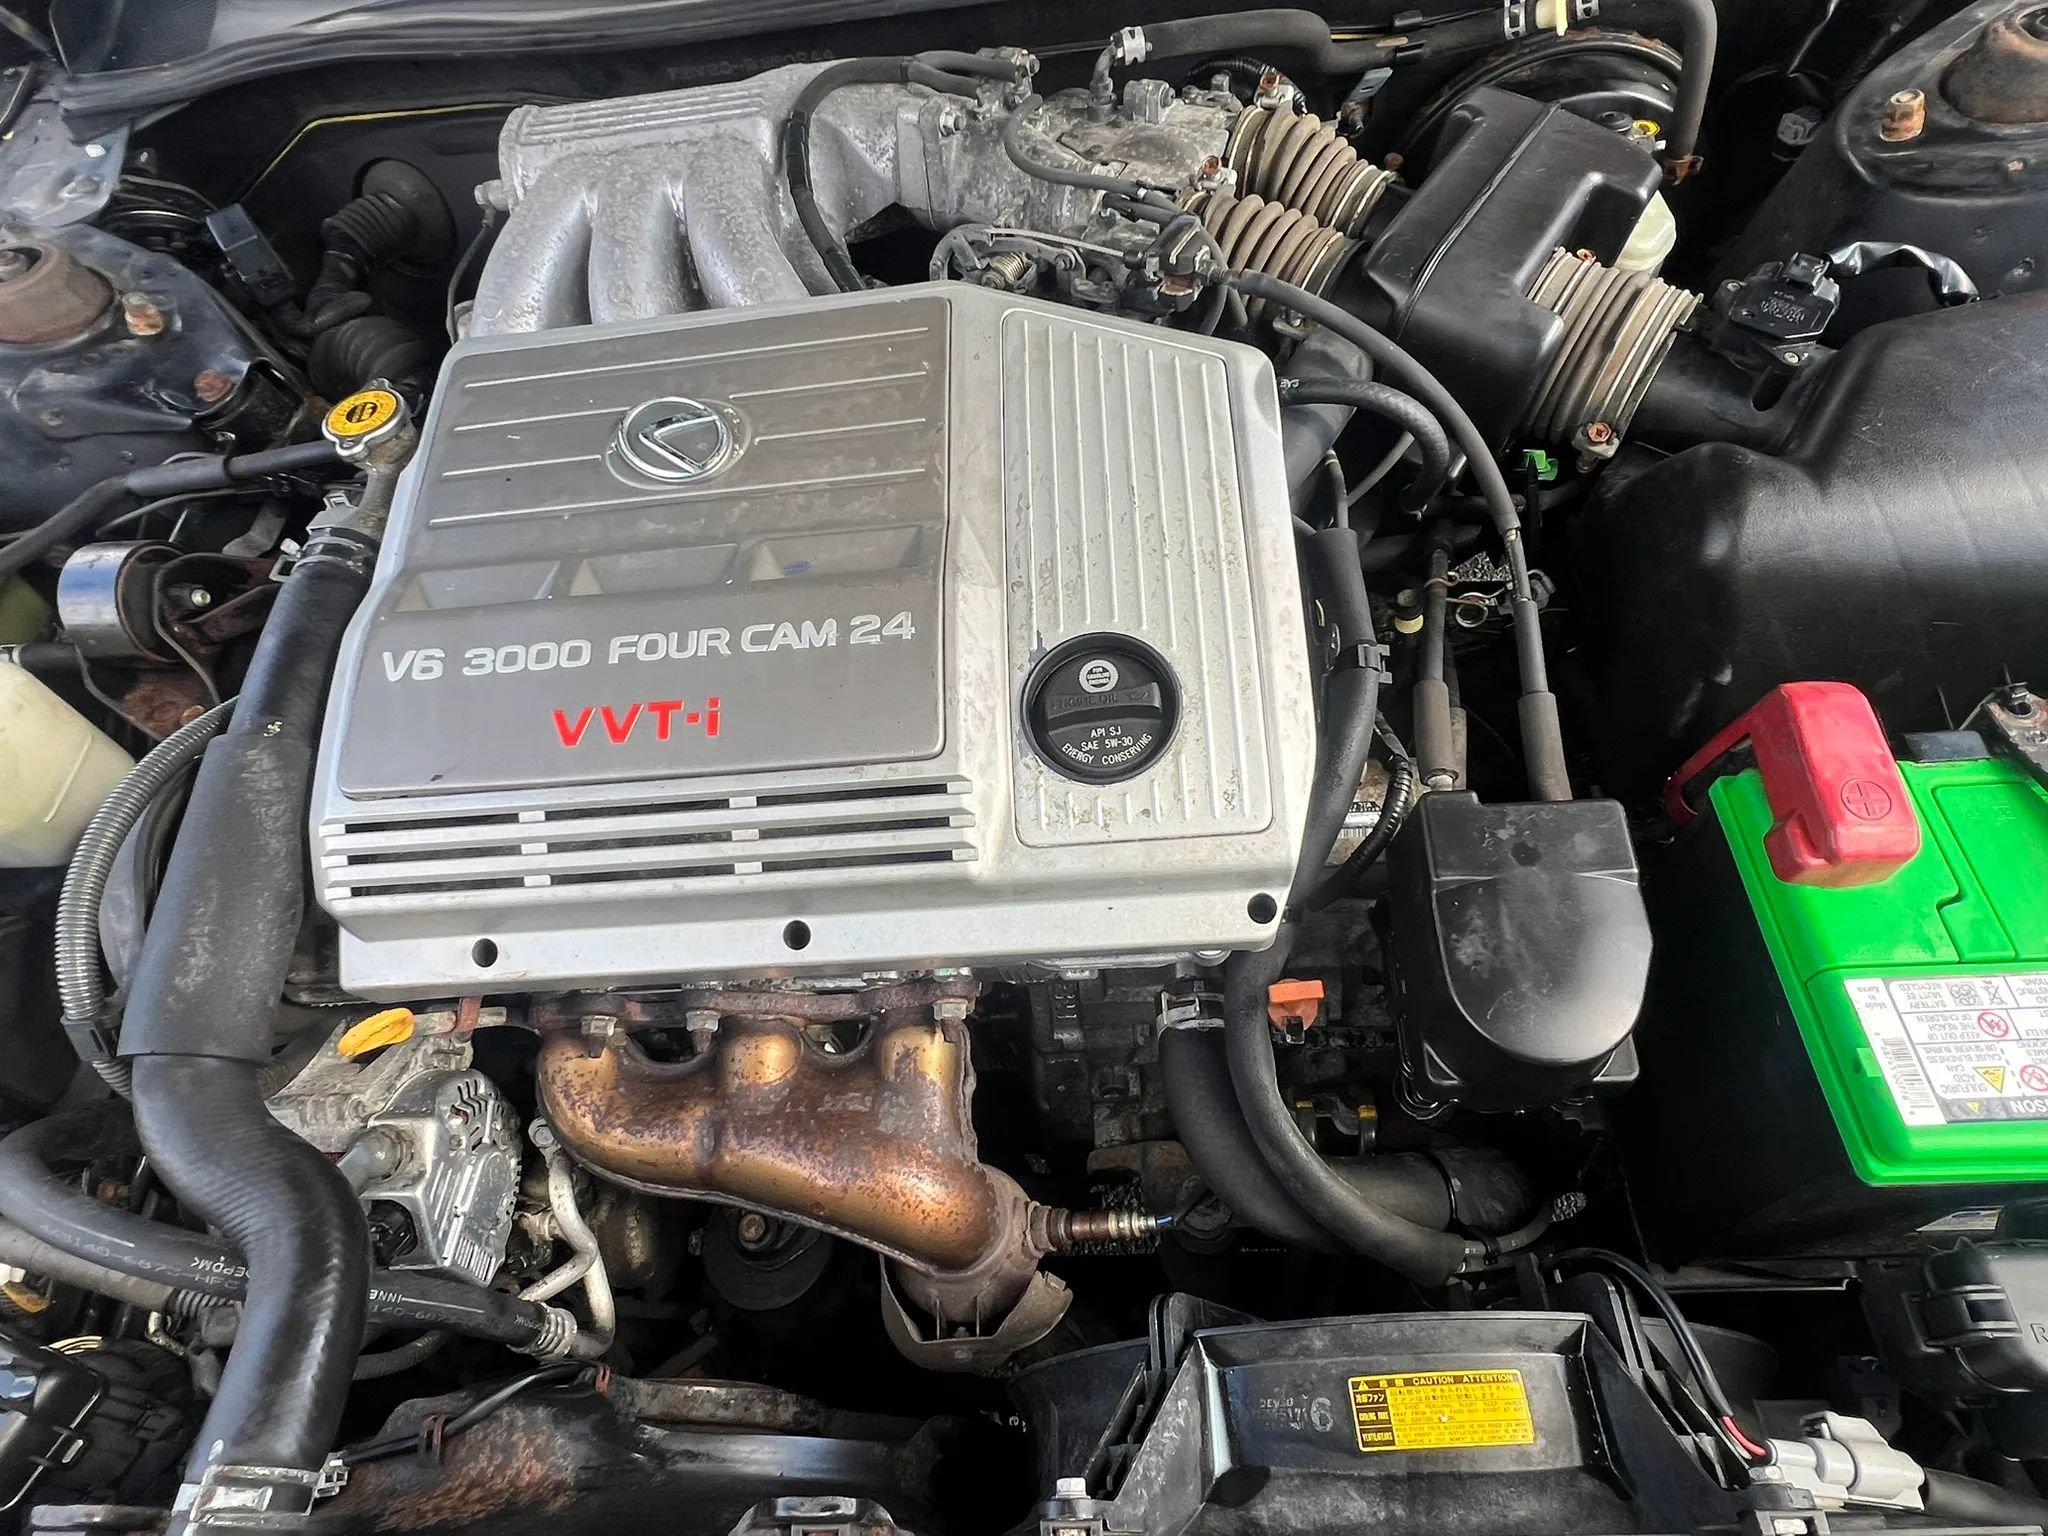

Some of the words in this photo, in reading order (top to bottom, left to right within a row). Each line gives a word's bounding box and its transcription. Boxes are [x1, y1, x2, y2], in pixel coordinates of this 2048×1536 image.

[382, 648, 444, 682] V6
[462, 639, 592, 676] 3000
[608, 626, 731, 665] FOUR
[741, 618, 837, 652] CAM
[849, 611, 916, 646] 24
[1080, 740, 1099, 752] SAE
[1104, 736, 1134, 749] 5W-30
[1090, 727, 1106, 739] API
[1109, 725, 1122, 736] SJ
[1061, 742, 1095, 765] ENERGY
[1101, 733, 1153, 766] CONSERVING
[1413, 1376, 1455, 1386] CAUTION
[1463, 1373, 1513, 1383] ATTENTION
[1311, 1397, 1334, 1433] 6
